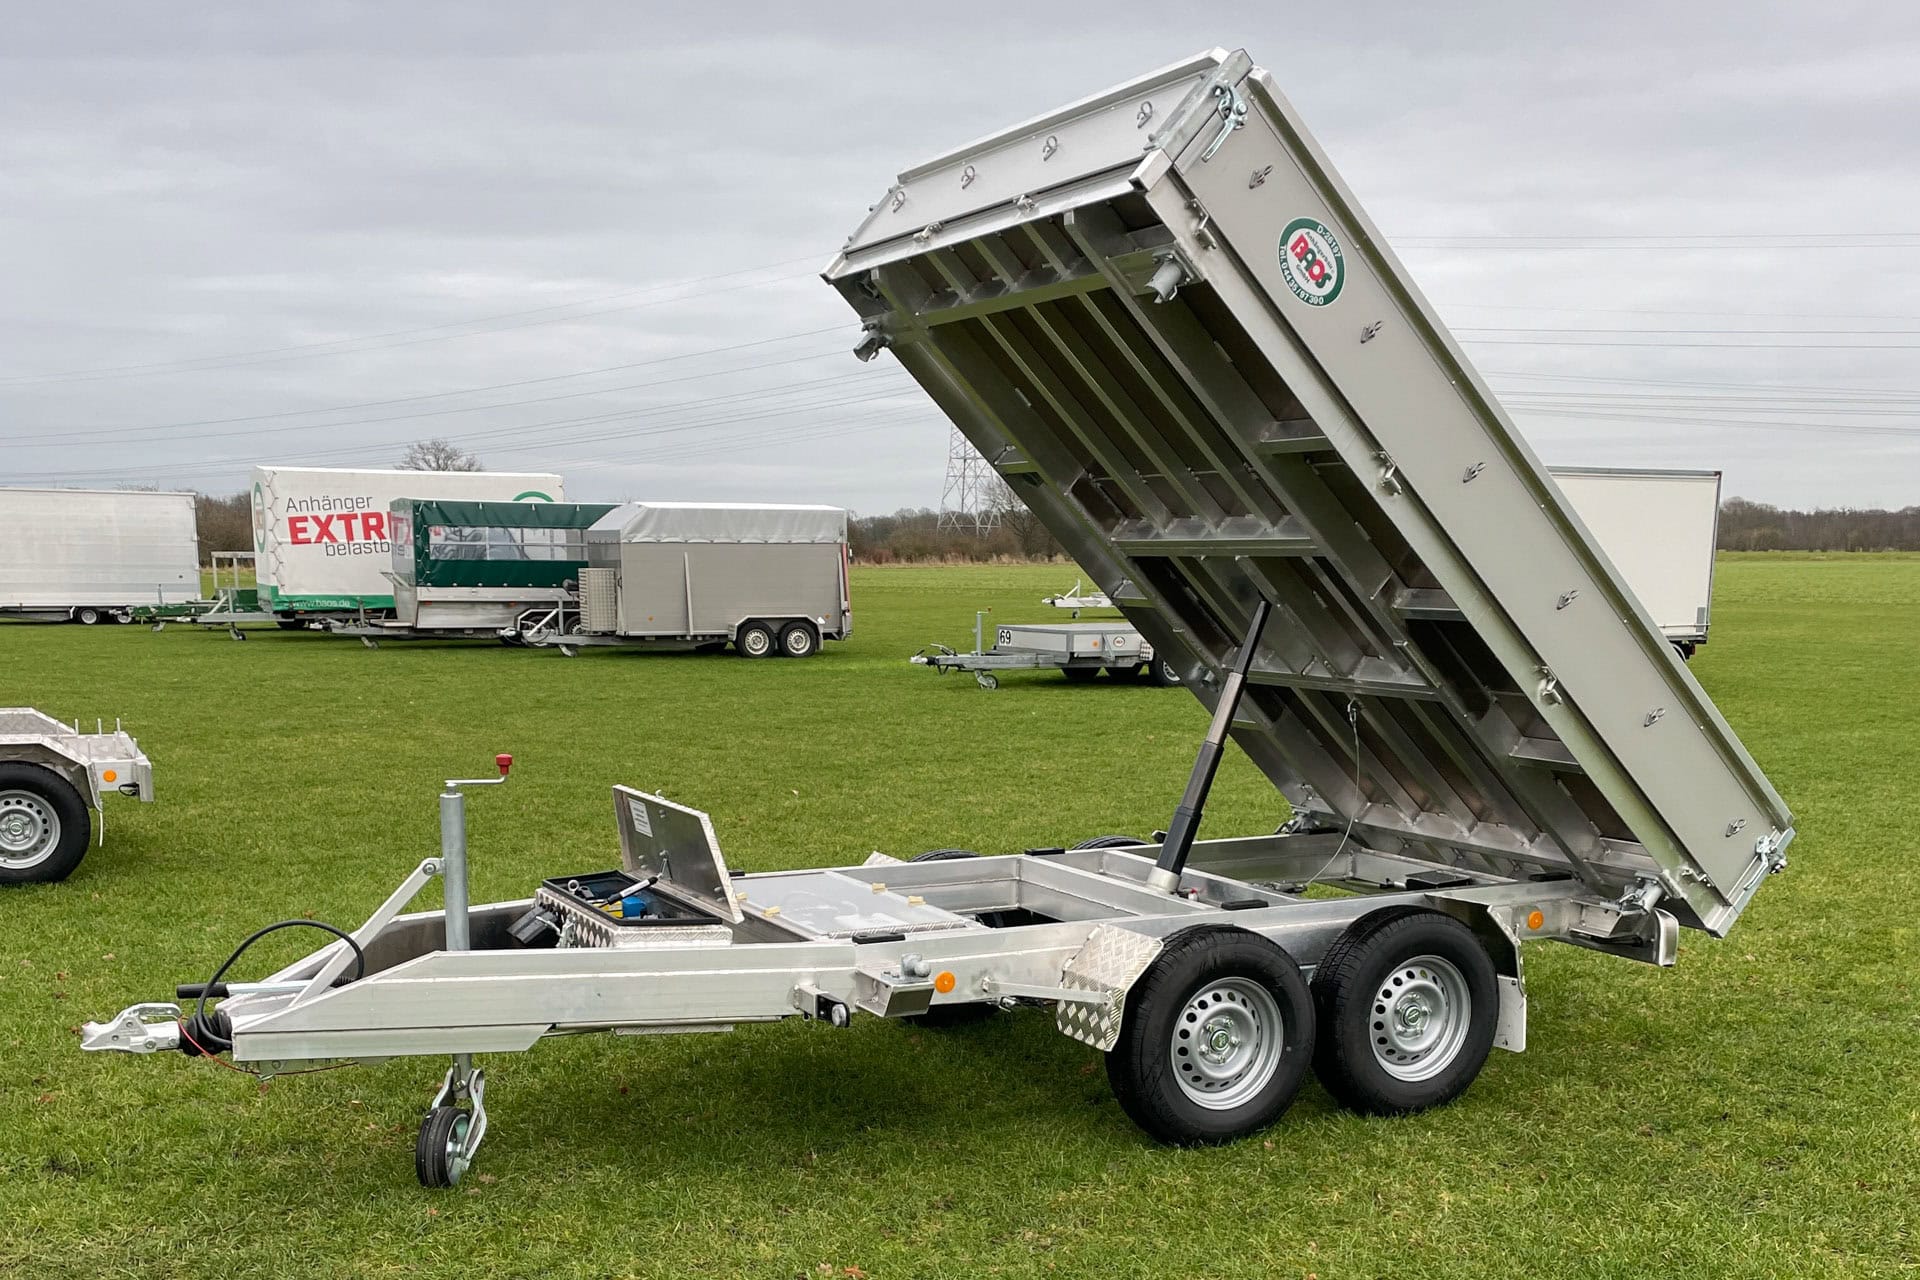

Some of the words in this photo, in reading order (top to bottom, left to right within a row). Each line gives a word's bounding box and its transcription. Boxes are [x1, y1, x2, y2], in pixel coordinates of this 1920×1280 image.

[1290, 233, 1333, 289] BAOS
[285, 496, 373, 513] Anhänger
[288, 511, 412, 545] EXTR
[1000, 630, 1012, 646] 69
